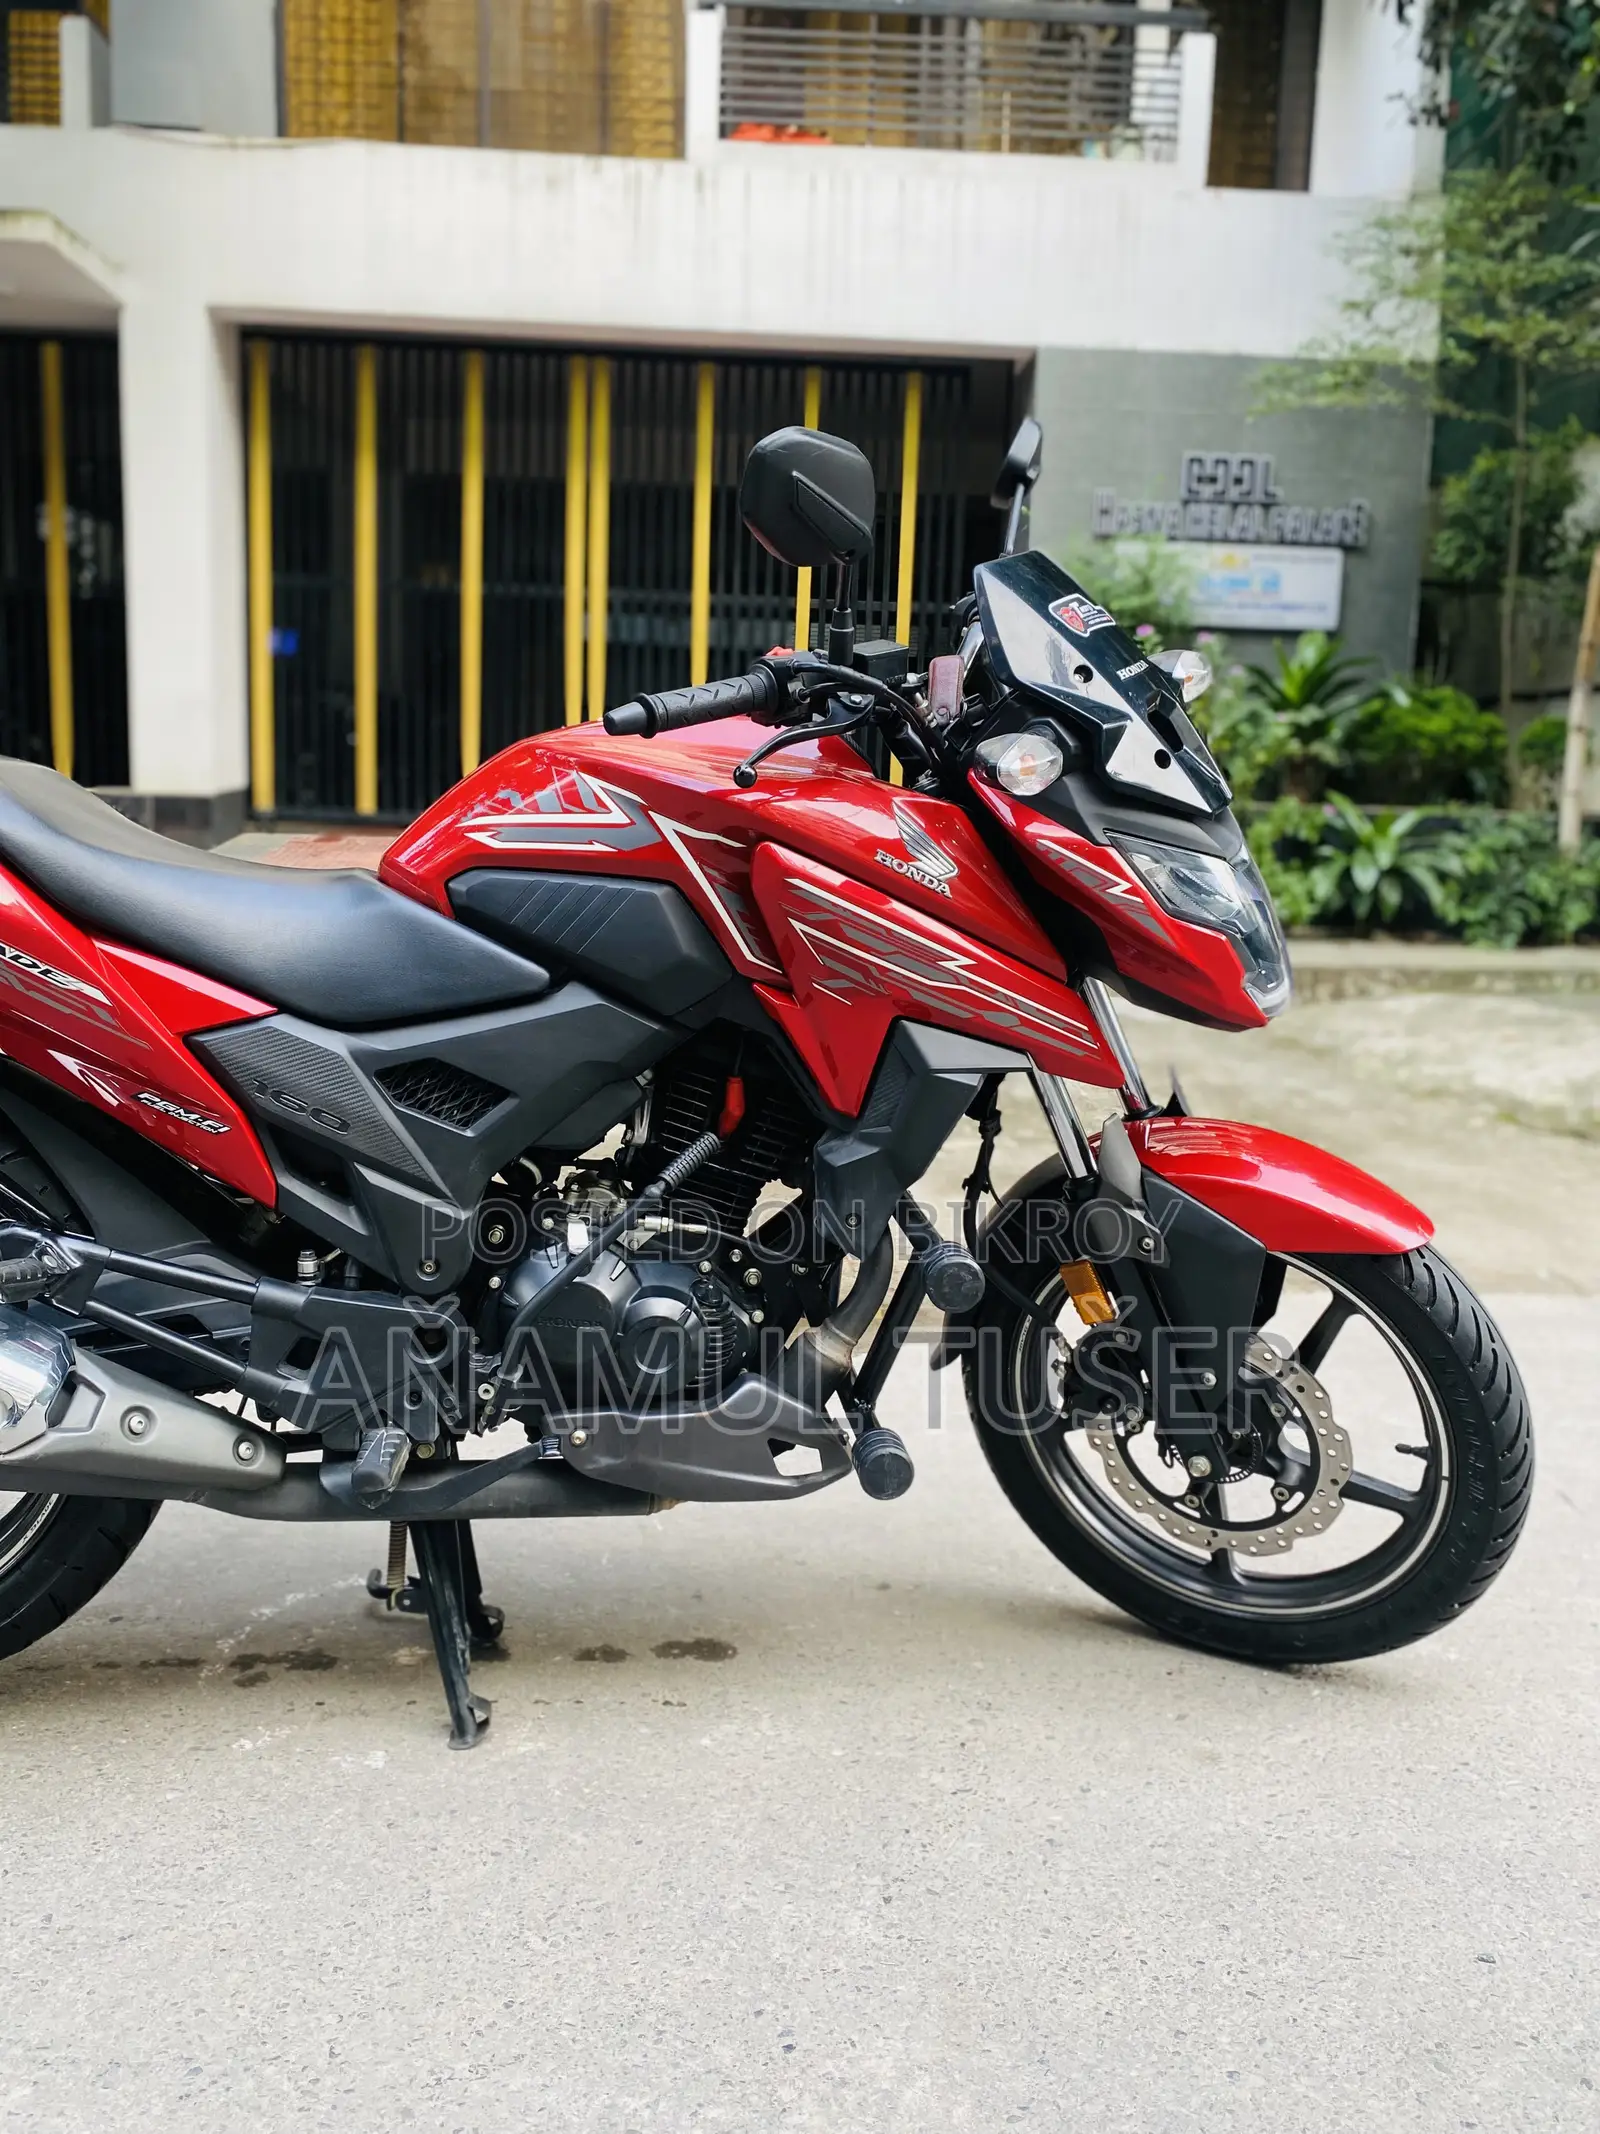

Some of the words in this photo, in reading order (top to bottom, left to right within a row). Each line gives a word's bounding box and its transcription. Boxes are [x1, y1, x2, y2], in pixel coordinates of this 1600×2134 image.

[1115, 660, 1149, 680] HONDA
[874, 849, 953, 898] HONDA
[140, 1099, 166, 1113] FUEL
[167, 1111, 219, 1134] INJECTION
